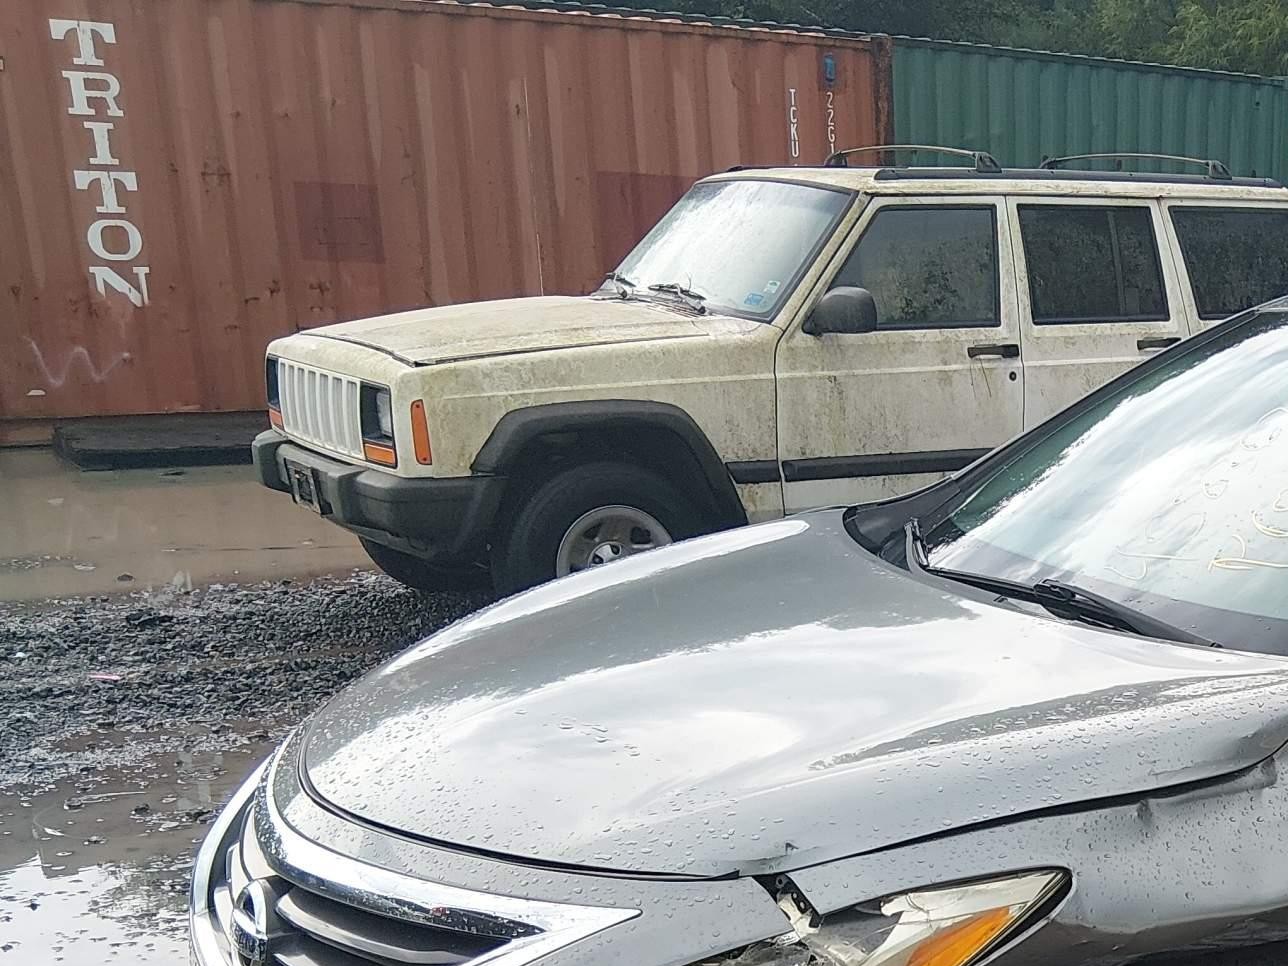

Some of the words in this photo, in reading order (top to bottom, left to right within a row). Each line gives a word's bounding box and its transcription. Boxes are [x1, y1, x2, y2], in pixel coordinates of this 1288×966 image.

[789, 88, 799, 157] TCKU
[827, 92, 836, 154] 22G1
[49, 19, 150, 307] TRITON
